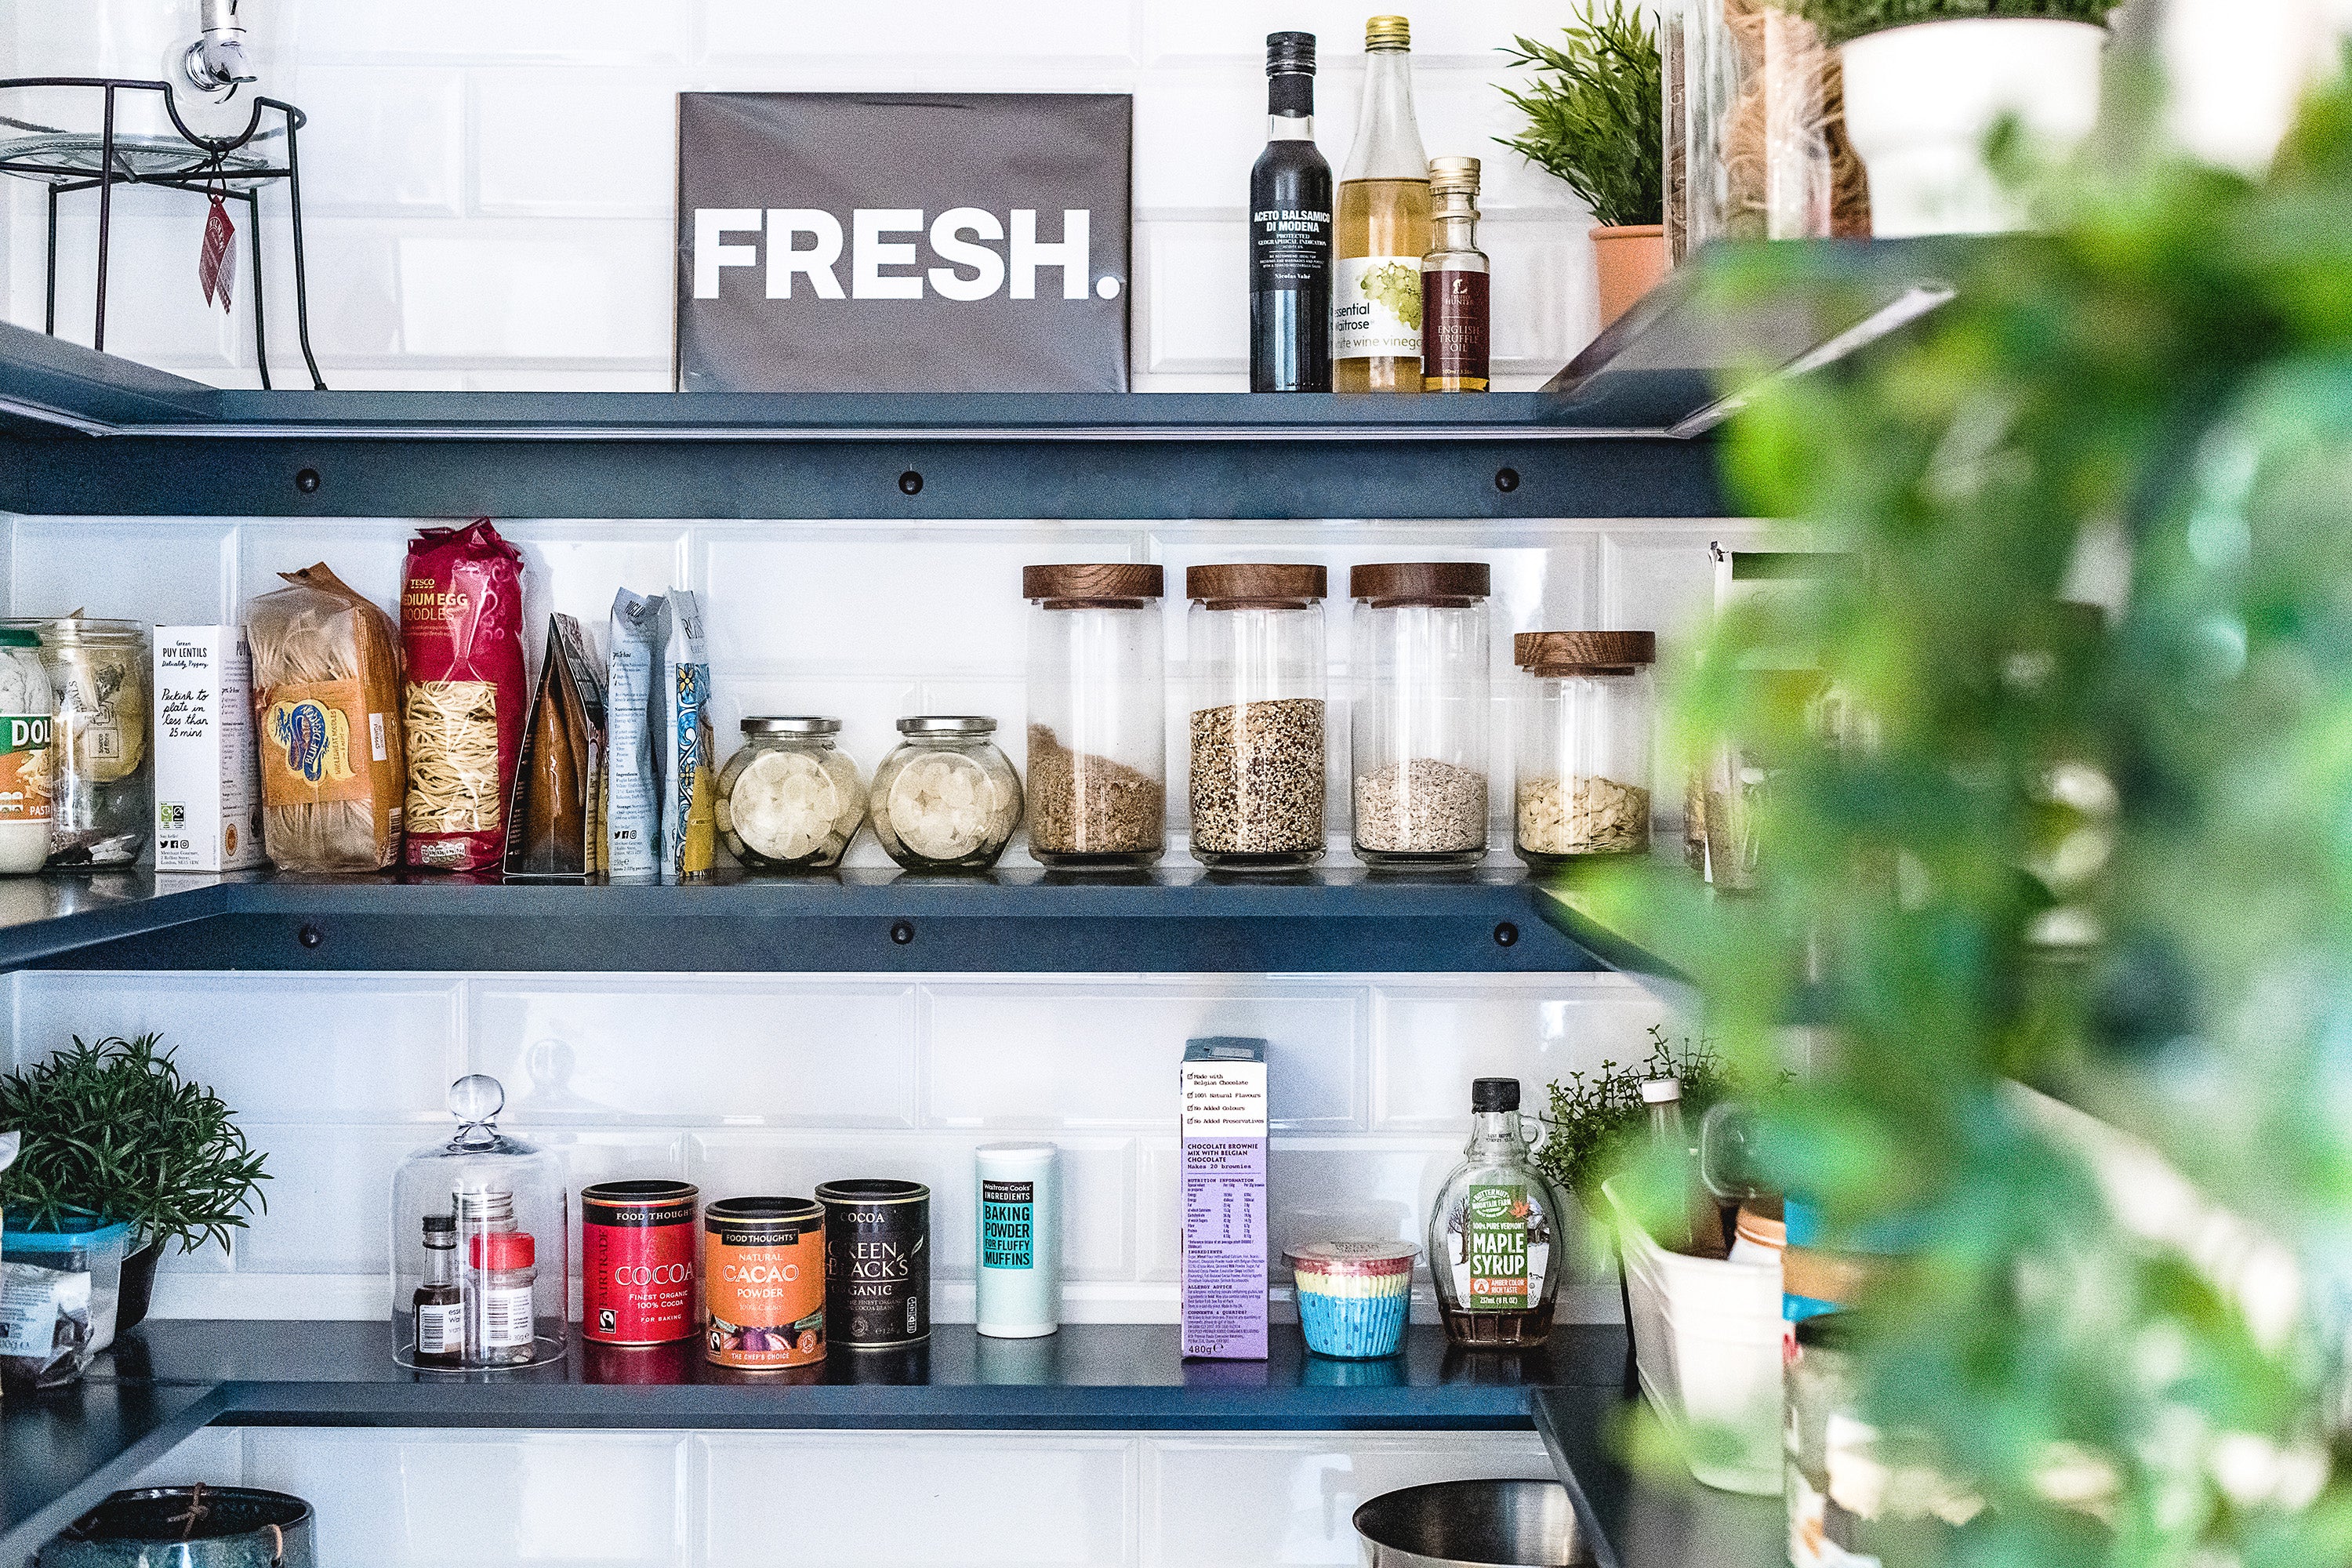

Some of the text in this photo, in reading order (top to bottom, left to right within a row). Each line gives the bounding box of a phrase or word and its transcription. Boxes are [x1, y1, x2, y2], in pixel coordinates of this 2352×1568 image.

[1254, 210, 1330, 223] ACETO BALSAMICO
[1266, 221, 1319, 233] DI MODENA
[694, 207, 1120, 301] FRESH.
[1438, 325, 1479, 336] ENGLISH
[1353, 336, 1380, 347] wine
[1439, 334, 1479, 344] TRUFFLE
[1450, 343, 1468, 353] OIL
[401, 593, 468, 606] EDIUM EGG
[162, 648, 207, 658] PUY LENTILS
[162, 688, 194, 701] Peckish
[196, 688, 209, 701] to
[162, 701, 188, 719] plate
[162, 713, 209, 726] less than
[169, 728, 202, 738] 25 mins
[304, 744, 318, 764] BLUE
[983, 1183, 1009, 1192] Waitrose
[984, 1192, 1030, 1201] INGREDIENTS
[615, 1213, 645, 1221] FOOD
[985, 1206, 1030, 1221] BAKING
[985, 1222, 1030, 1239] POWDER
[726, 1234, 794, 1243] FOOD THOUGHTS
[1473, 1233, 1524, 1254] MAPLE
[828, 1241, 898, 1259] EEN
[985, 1239, 1030, 1251] FOR FLUFFY
[739, 1254, 783, 1262] NATURAL
[985, 1252, 1030, 1266] MUFFINS
[598, 1229, 608, 1307] FAIRTRADE
[829, 1254, 909, 1278] BACK'S
[1472, 1254, 1525, 1276] SYRUP
[615, 1261, 695, 1286] COCOA
[723, 1265, 800, 1283] CACAO
[737, 1288, 784, 1299] POWDER
[832, 1285, 893, 1296] GANIC
[1477, 1283, 1486, 1292] A
[659, 1290, 688, 1300] ORGANIC
[744, 1352, 765, 1361] CHEF'S
[1189, 1345, 1212, 1356] 480g
